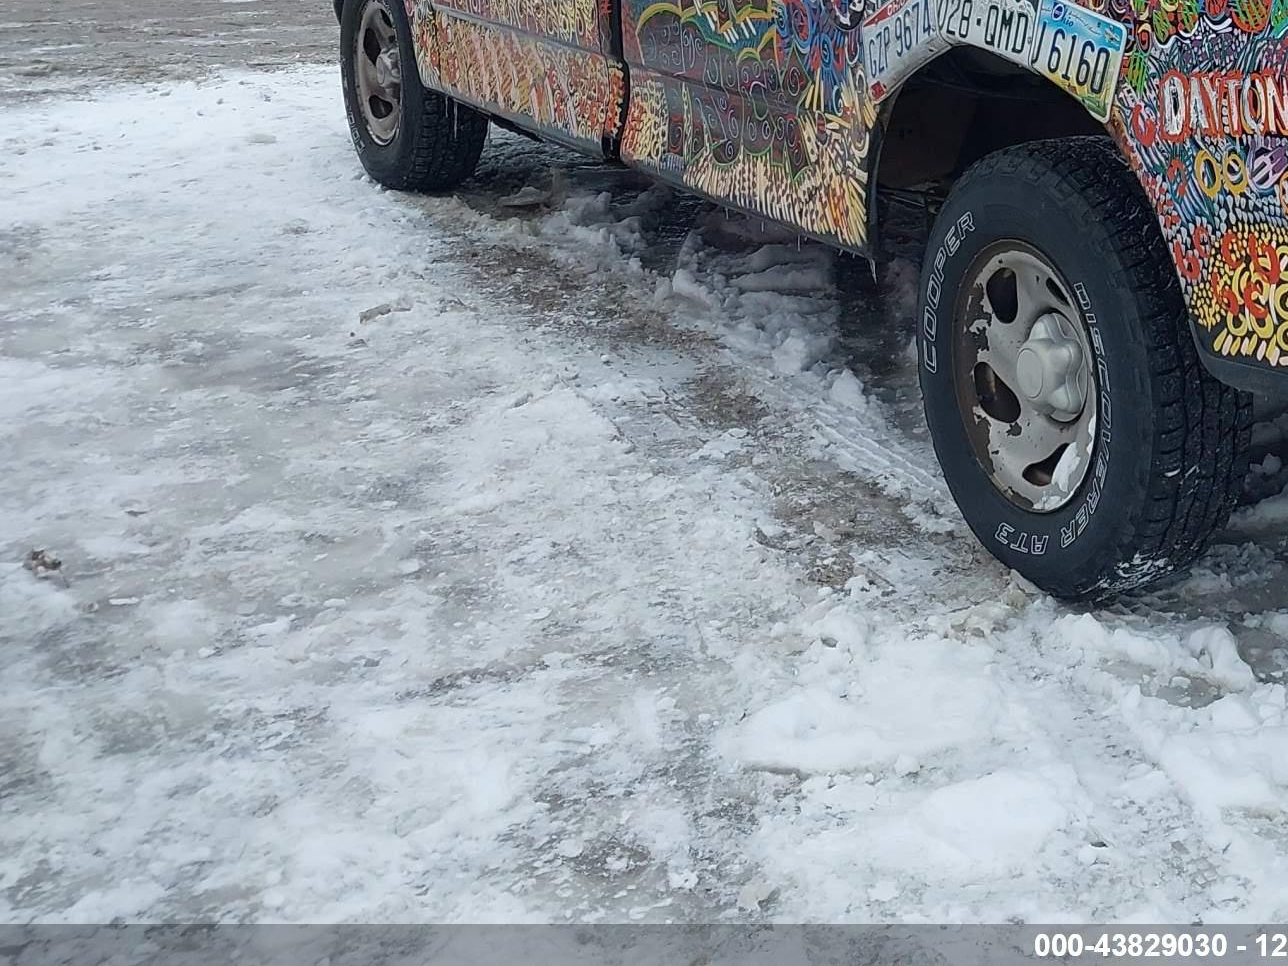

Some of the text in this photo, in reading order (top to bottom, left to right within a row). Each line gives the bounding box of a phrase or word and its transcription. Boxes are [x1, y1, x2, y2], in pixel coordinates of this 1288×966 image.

[1050, 1, 1074, 27] Ohio
[868, 26, 891, 78] GZP
[1049, 28, 1110, 95] 6160
[922, 211, 977, 374] COOPER
[994, 281, 1114, 556] DISCOVERER AT3
